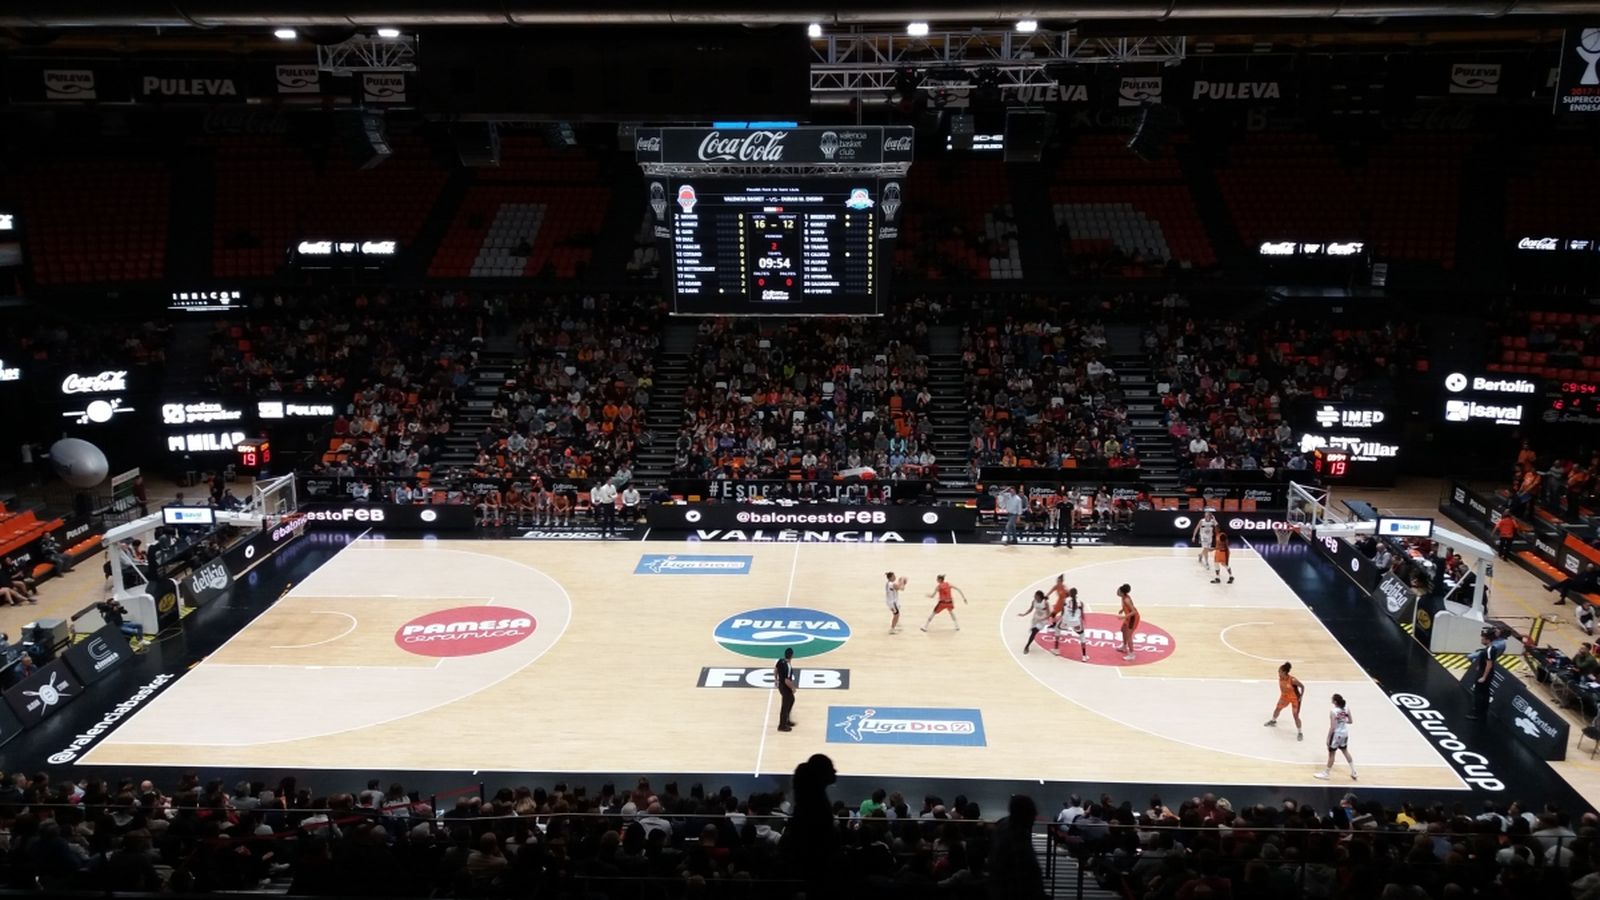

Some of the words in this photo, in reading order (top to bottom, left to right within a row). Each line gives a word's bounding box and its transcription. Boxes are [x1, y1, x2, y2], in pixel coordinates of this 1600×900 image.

[47, 72, 91, 84] PULEVA
[278, 67, 317, 78] PULEVA
[1453, 67, 1497, 77] PULEVA
[143, 76, 237, 96] PULEVA
[365, 76, 403, 88] PULEVA
[1122, 80, 1161, 90] PULEVA
[1193, 81, 1280, 100] PULEVA
[636, 136, 661, 151] Coca-Cola
[698, 131, 789, 162] Coca-Cola
[883, 136, 912, 152] Coca-Cola
[754, 219, 766, 229] 16
[783, 219, 794, 229] 12
[771, 242, 778, 251] 2
[1518, 237, 1560, 251] Coca-Cola
[758, 258, 792, 269] 09:54
[758, 278, 765, 286] 0
[786, 278, 793, 286] 0
[61, 370, 128, 395] Coca-Cola
[1473, 376, 1536, 394] Bertolín
[1562, 382, 1597, 393] 09:54
[286, 404, 334, 416] PULEVA
[1342, 410, 1385, 423] IMED
[1469, 401, 1523, 420] isaval
[1351, 441, 1399, 457] Villar
[243, 453, 257, 466] 19
[1330, 462, 1346, 475] 19
[402, 617, 532, 636] PAMESA
[731, 618, 841, 631] PULEVA
[404, 627, 525, 644] ceramica
[47, 672, 175, 765] @valenciabasket
[862, 720, 907, 732] Liga
